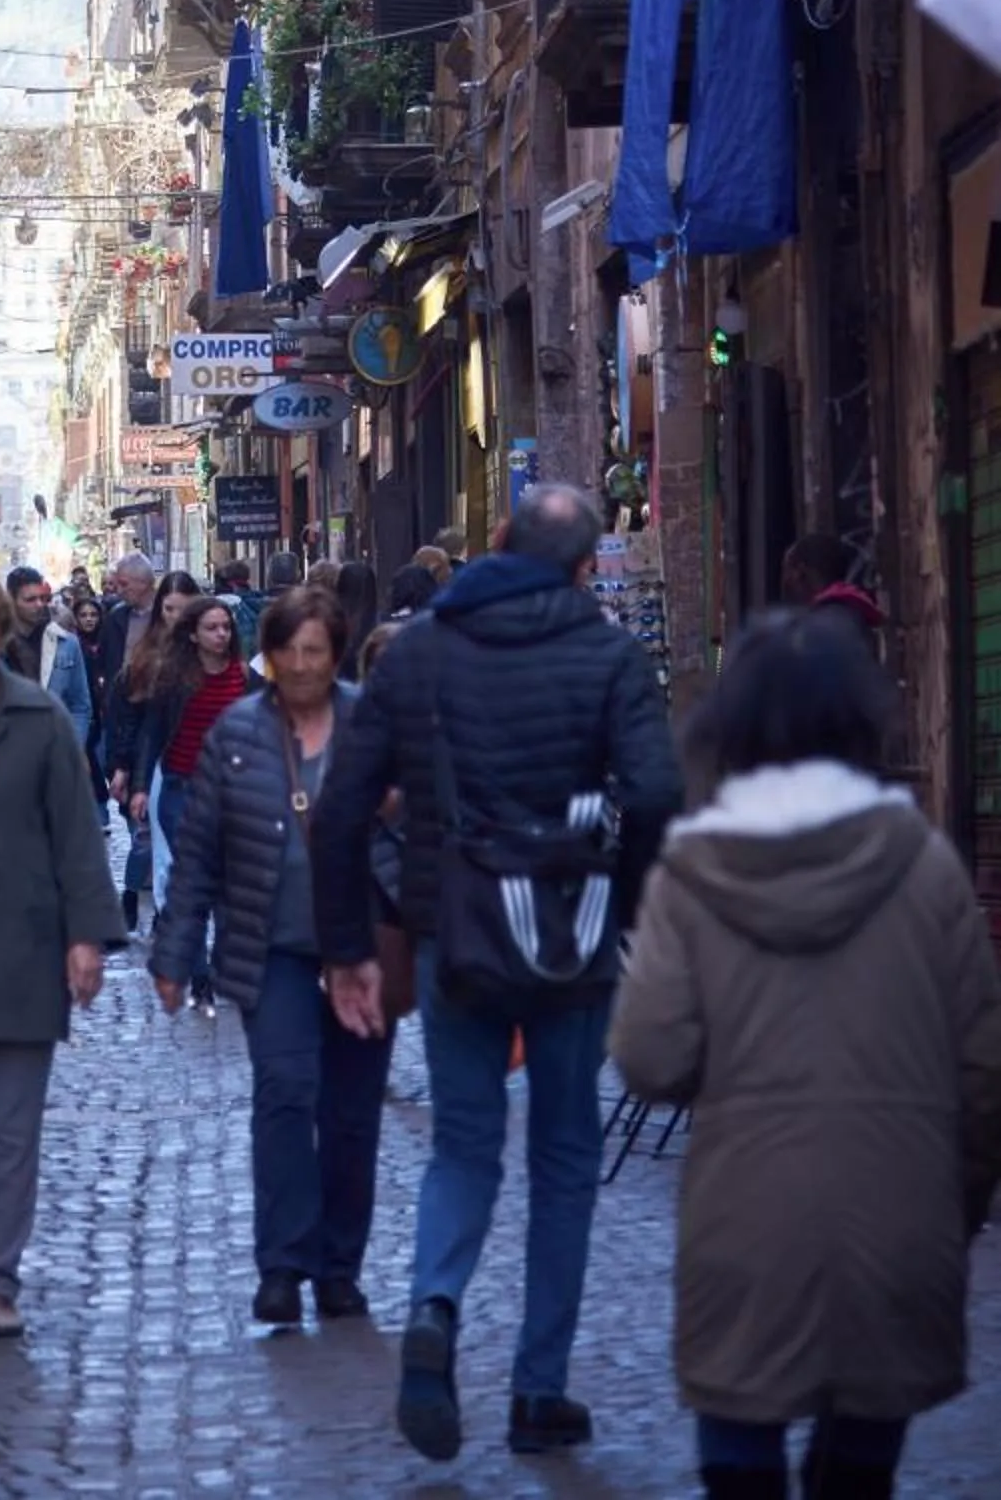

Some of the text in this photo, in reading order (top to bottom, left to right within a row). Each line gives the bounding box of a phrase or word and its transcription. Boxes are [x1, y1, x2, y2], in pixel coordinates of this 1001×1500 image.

[173, 339, 273, 359] COMPRO
[190, 365, 259, 389] ORO
[271, 394, 334, 418] BAR
